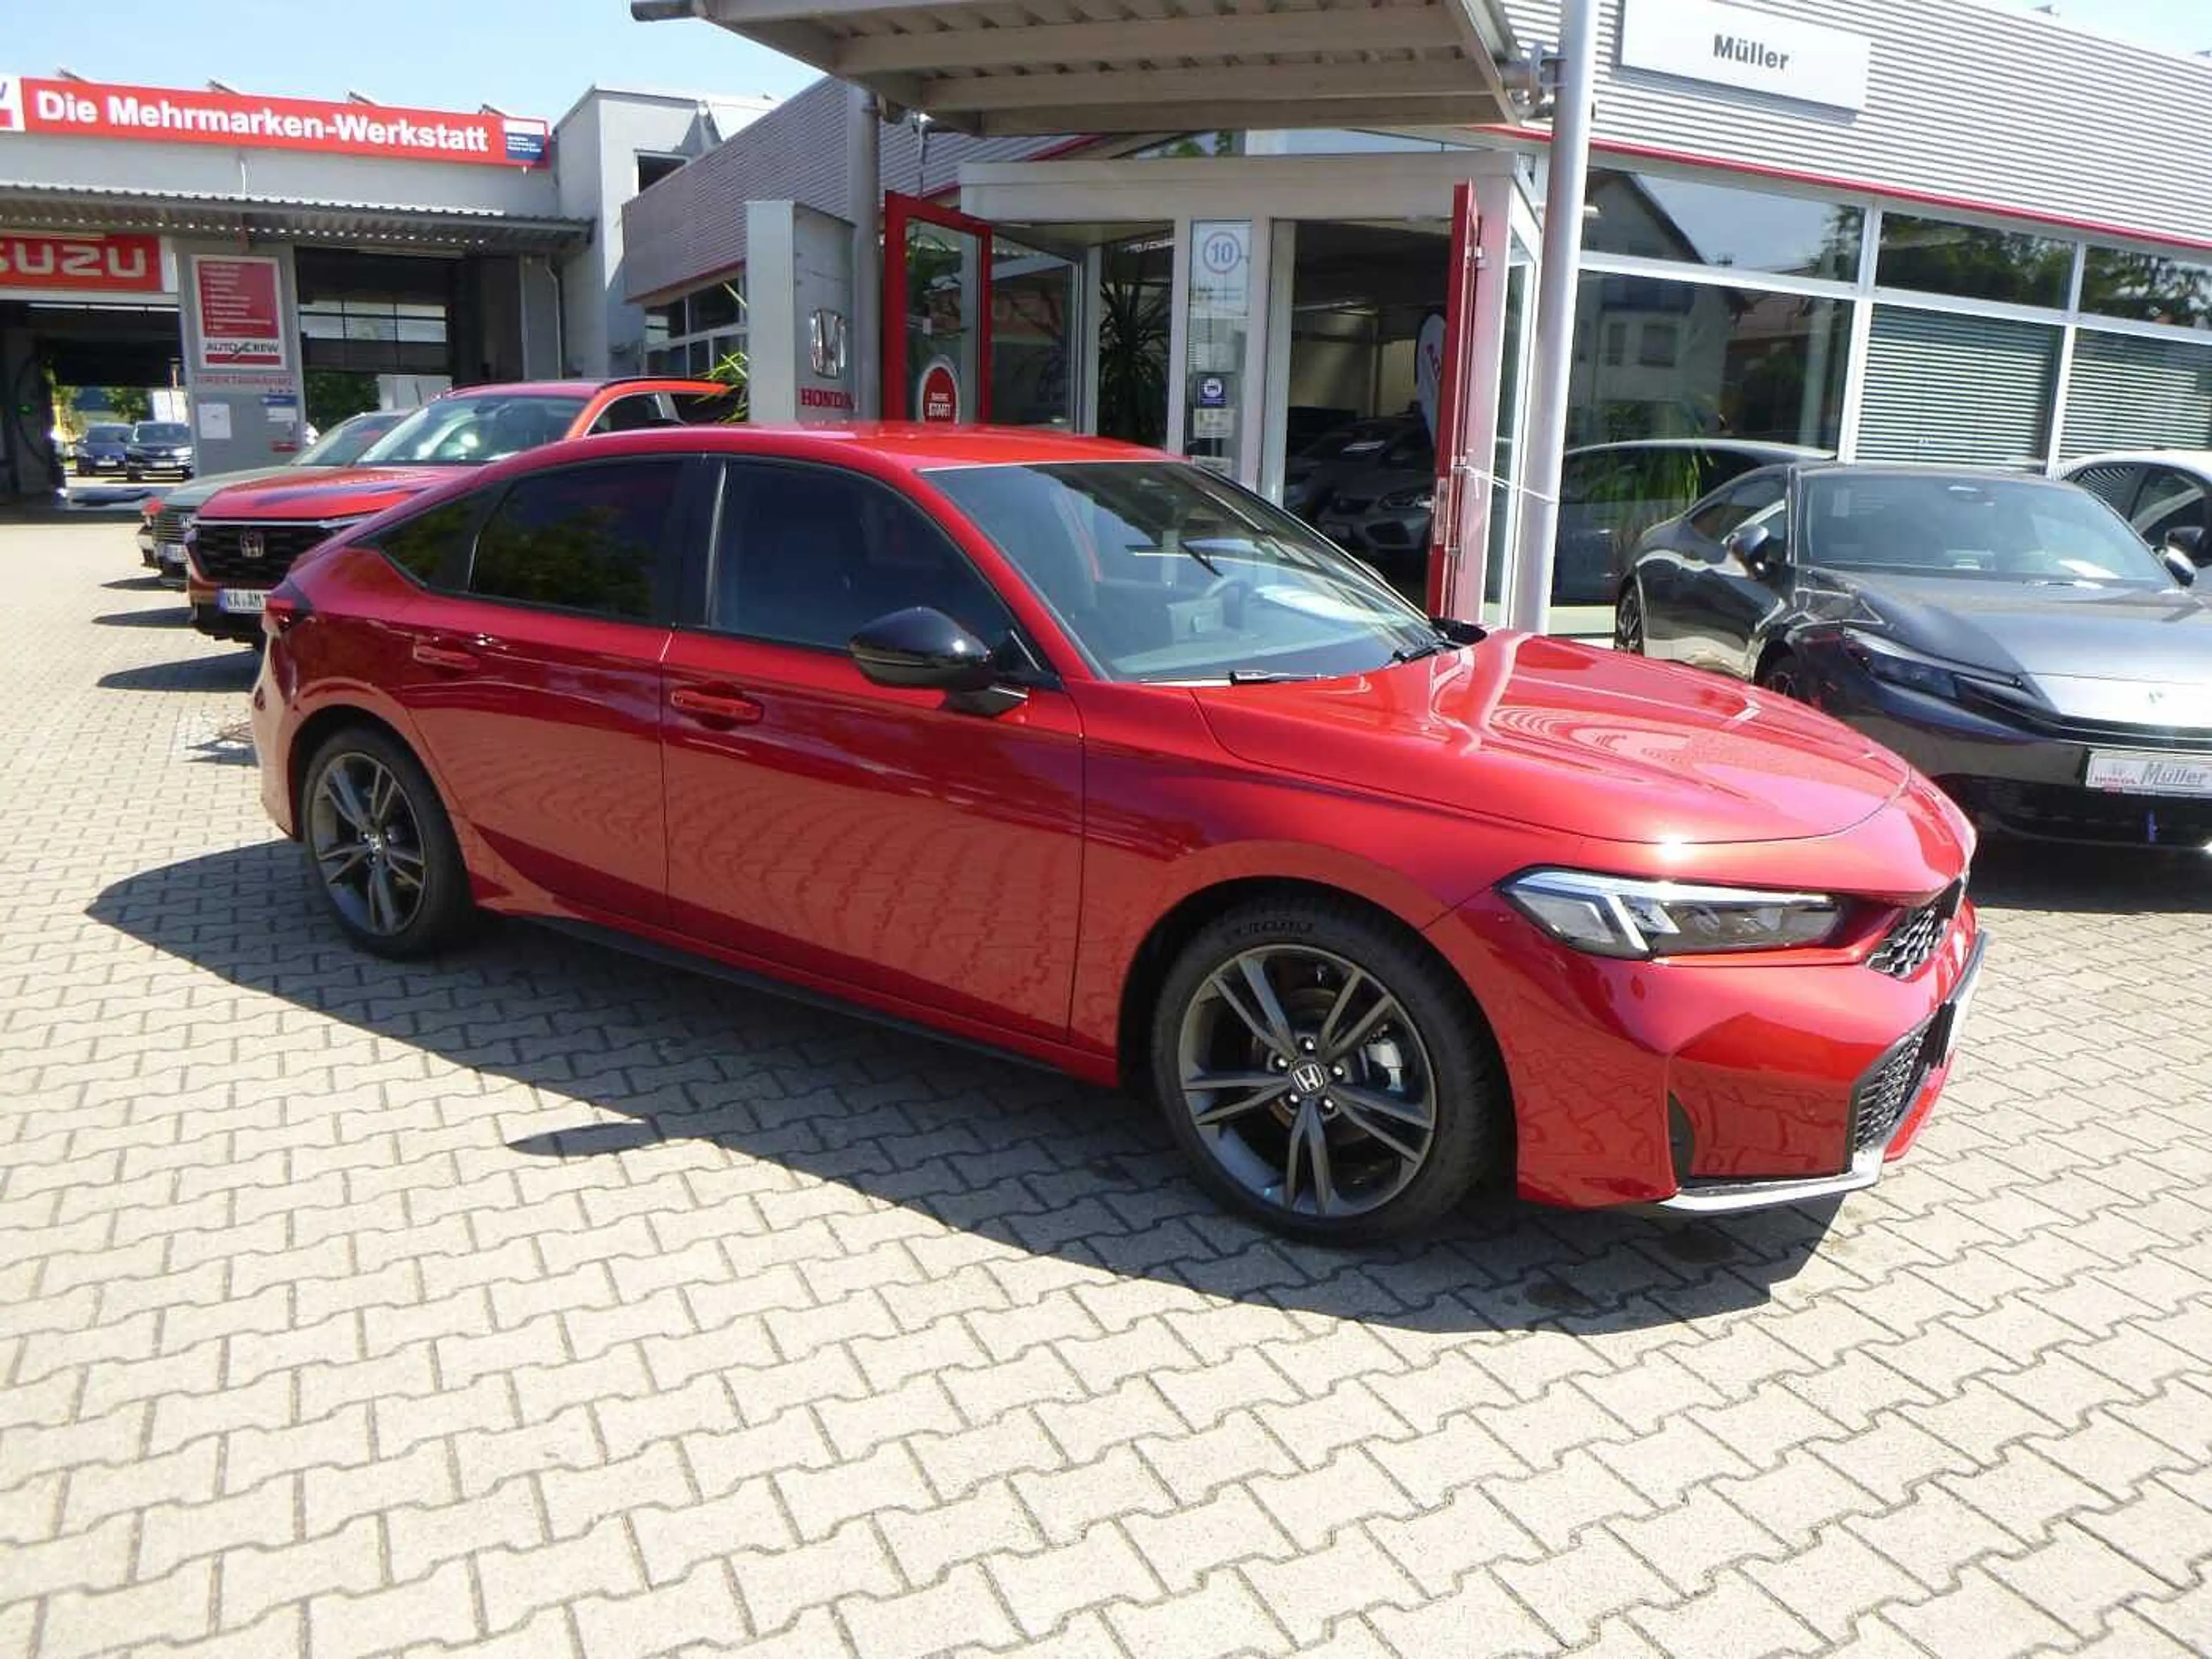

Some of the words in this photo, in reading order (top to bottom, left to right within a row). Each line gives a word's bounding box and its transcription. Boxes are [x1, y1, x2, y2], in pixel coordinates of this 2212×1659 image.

[1713, 33, 1790, 70] Müller
[37, 89, 98, 123] Die
[107, 94, 489, 151] Mehrmarken-Werkstatt
[1211, 242, 1233, 264] 10
[800, 388, 854, 410] HONDA
